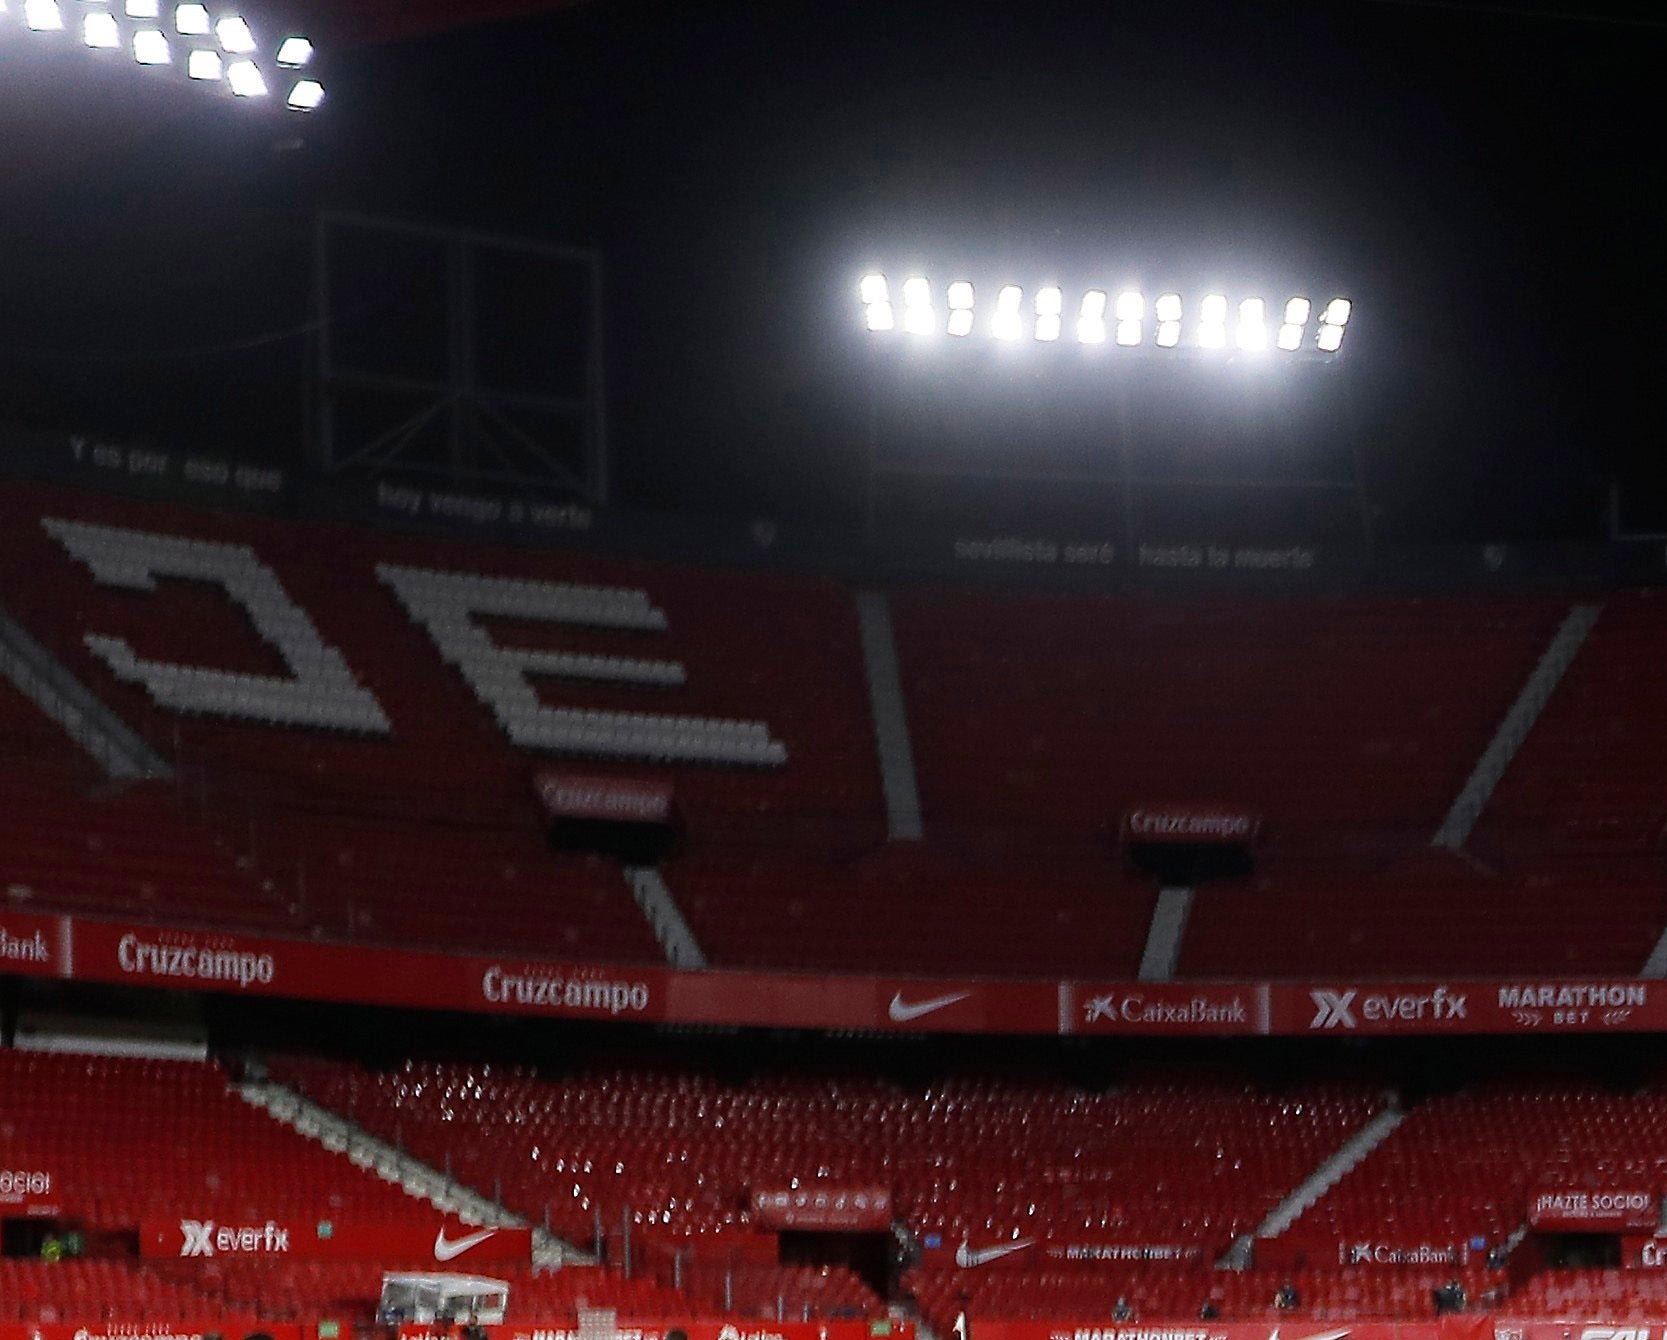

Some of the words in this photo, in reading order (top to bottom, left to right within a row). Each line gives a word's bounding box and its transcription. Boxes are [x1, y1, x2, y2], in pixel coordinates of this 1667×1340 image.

[118, 932, 274, 988] Cruzcampo
[482, 965, 649, 1015] Cruzcampo
[1361, 985, 1467, 1020] everfx
[1498, 985, 1646, 1008] MARATHON
[1120, 997, 1246, 1024] CaixaBank
[1553, 1011, 1590, 1024] BET
[1592, 1194, 1648, 1210] SOCIO!
[216, 1220, 288, 1252] everfx
